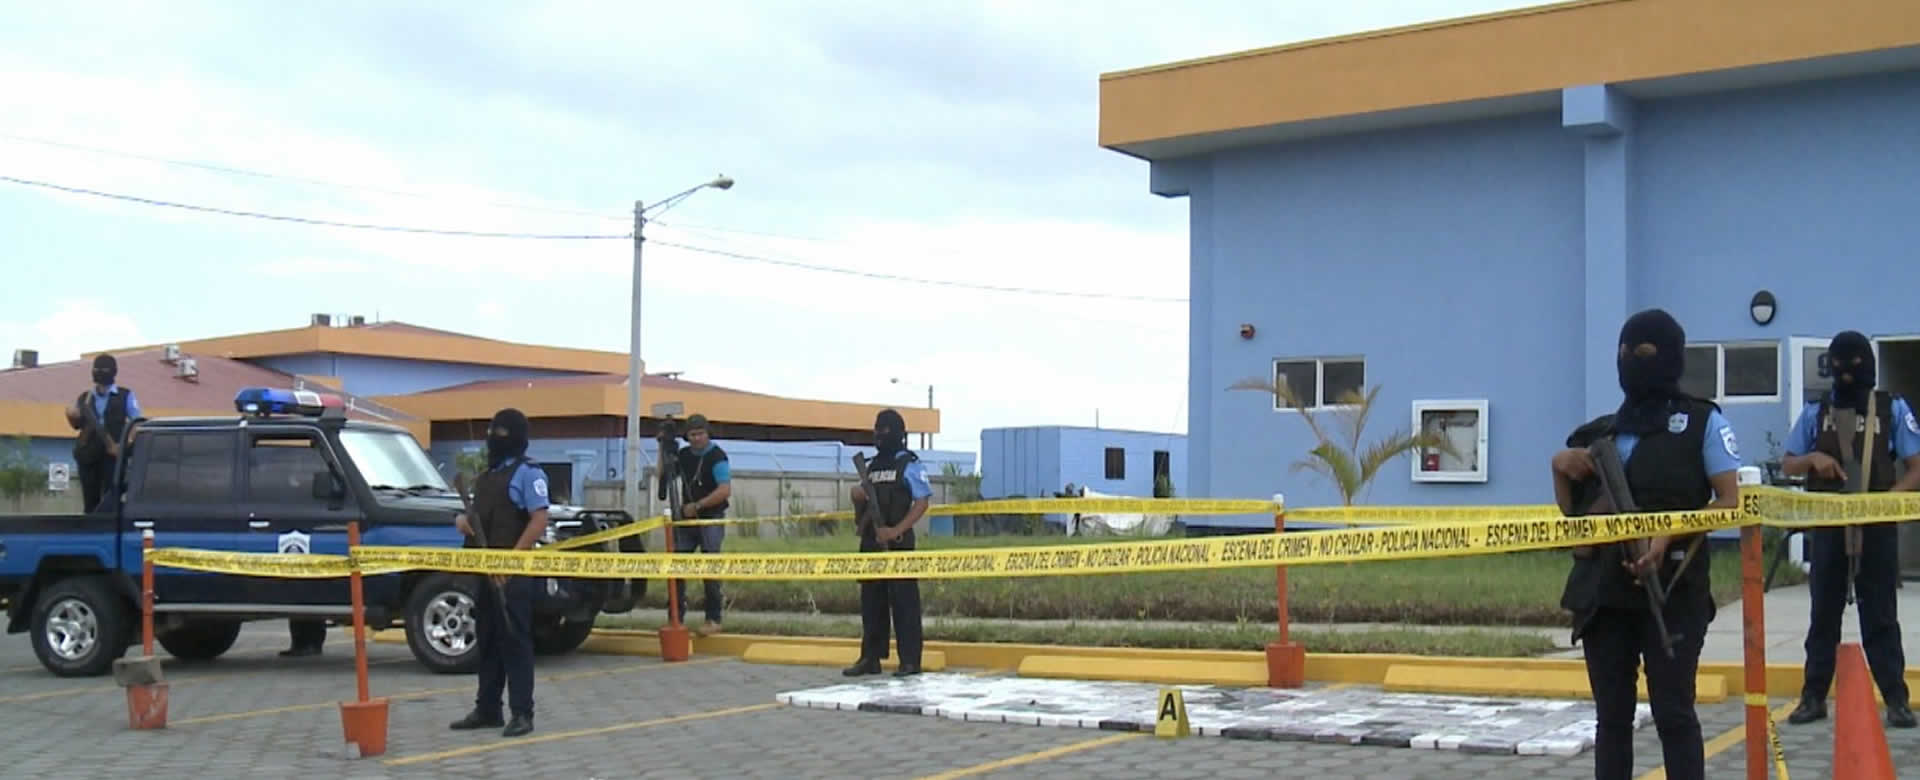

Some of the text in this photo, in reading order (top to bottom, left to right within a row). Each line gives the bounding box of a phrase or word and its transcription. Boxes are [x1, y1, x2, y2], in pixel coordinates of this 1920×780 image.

[1221, 527, 1471, 562] ESCENA DEL CRIMEN NO CRUZAR POLICIA NACIONAL
[1485, 523, 1528, 548] ESCENA
[1529, 520, 1550, 544] DEL
[1554, 518, 1597, 542] CRIMEN
[1605, 517, 1623, 536] NO
[1005, 544, 1210, 570] ESCENA DEL CRIMEN NO CRUZAR POLICIA NACIONAL
[1159, 693, 1177, 720] A
